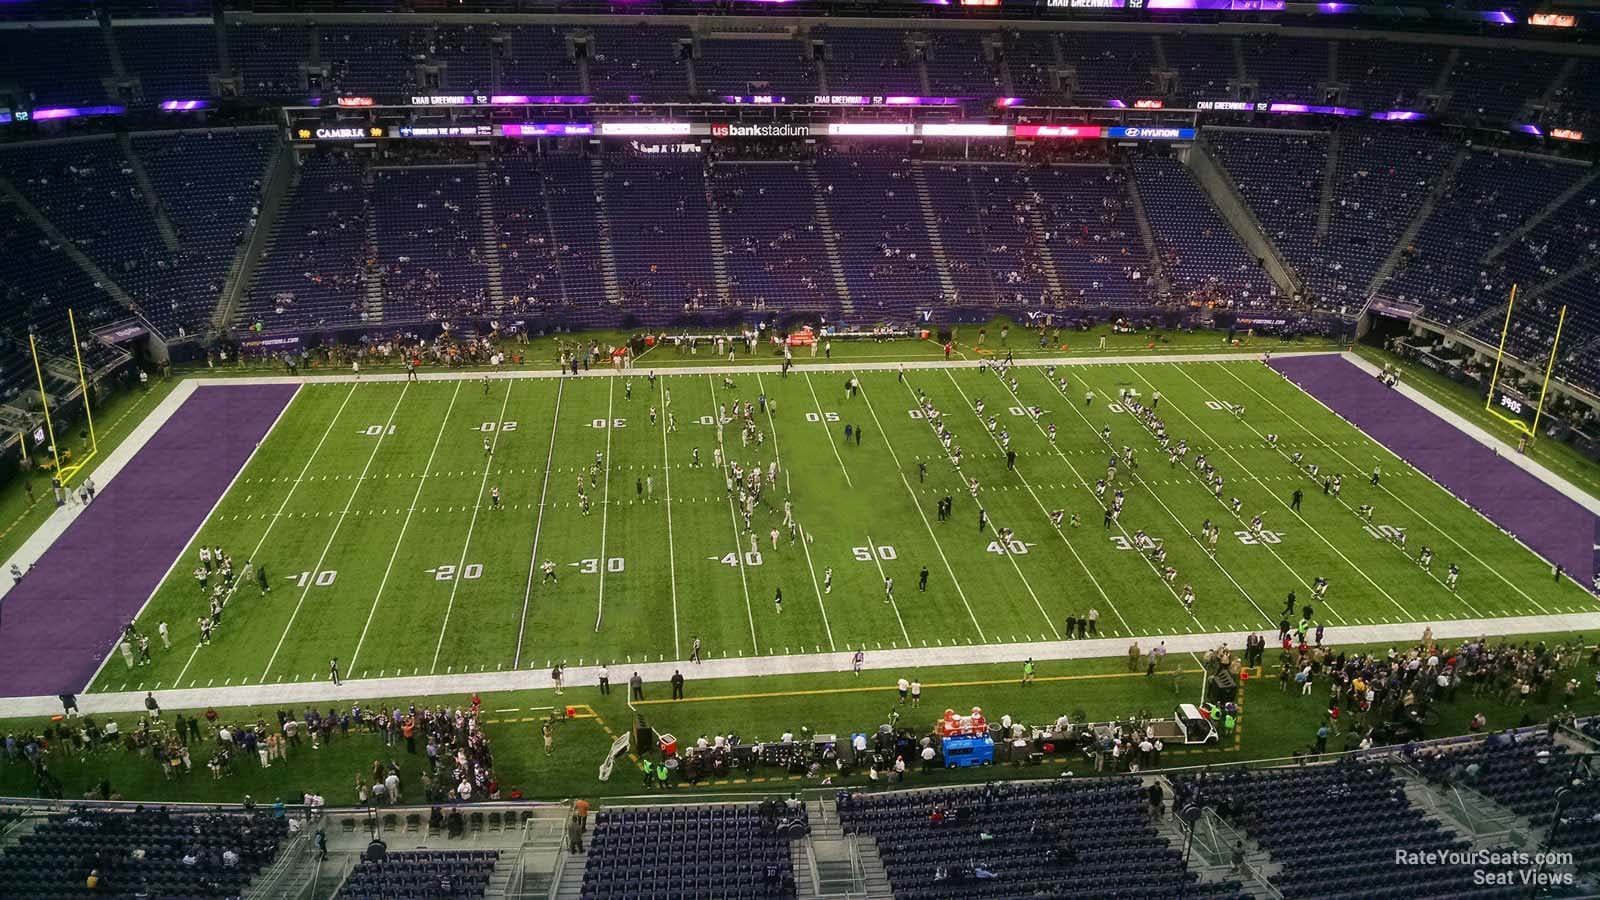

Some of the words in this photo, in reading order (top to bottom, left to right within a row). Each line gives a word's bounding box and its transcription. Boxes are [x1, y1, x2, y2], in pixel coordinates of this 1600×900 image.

[1129, 0, 1142, 8] 52
[412, 96, 429, 105] CHAD
[431, 96, 465, 104] GREENWAY
[476, 95, 487, 104] 52
[814, 95, 830, 104] CHAD
[832, 96, 863, 104] GREENWAY
[873, 96, 883, 104] 52
[1197, 101, 1212, 109] CHAD
[1214, 102, 1247, 110] GREENWAY
[1257, 102, 1267, 111] 52
[15, 111, 28, 121] 52
[316, 128, 365, 138] CAMBRIA
[1140, 128, 1180, 138] HYUNDAI
[1234, 530, 1282, 545] 20
[852, 545, 897, 562] 50
[987, 541, 1029, 555] 40
[580, 557, 625, 574] 30
[720, 552, 763, 567] 40
[435, 564, 483, 581] 20
[296, 571, 338, 587] 10
